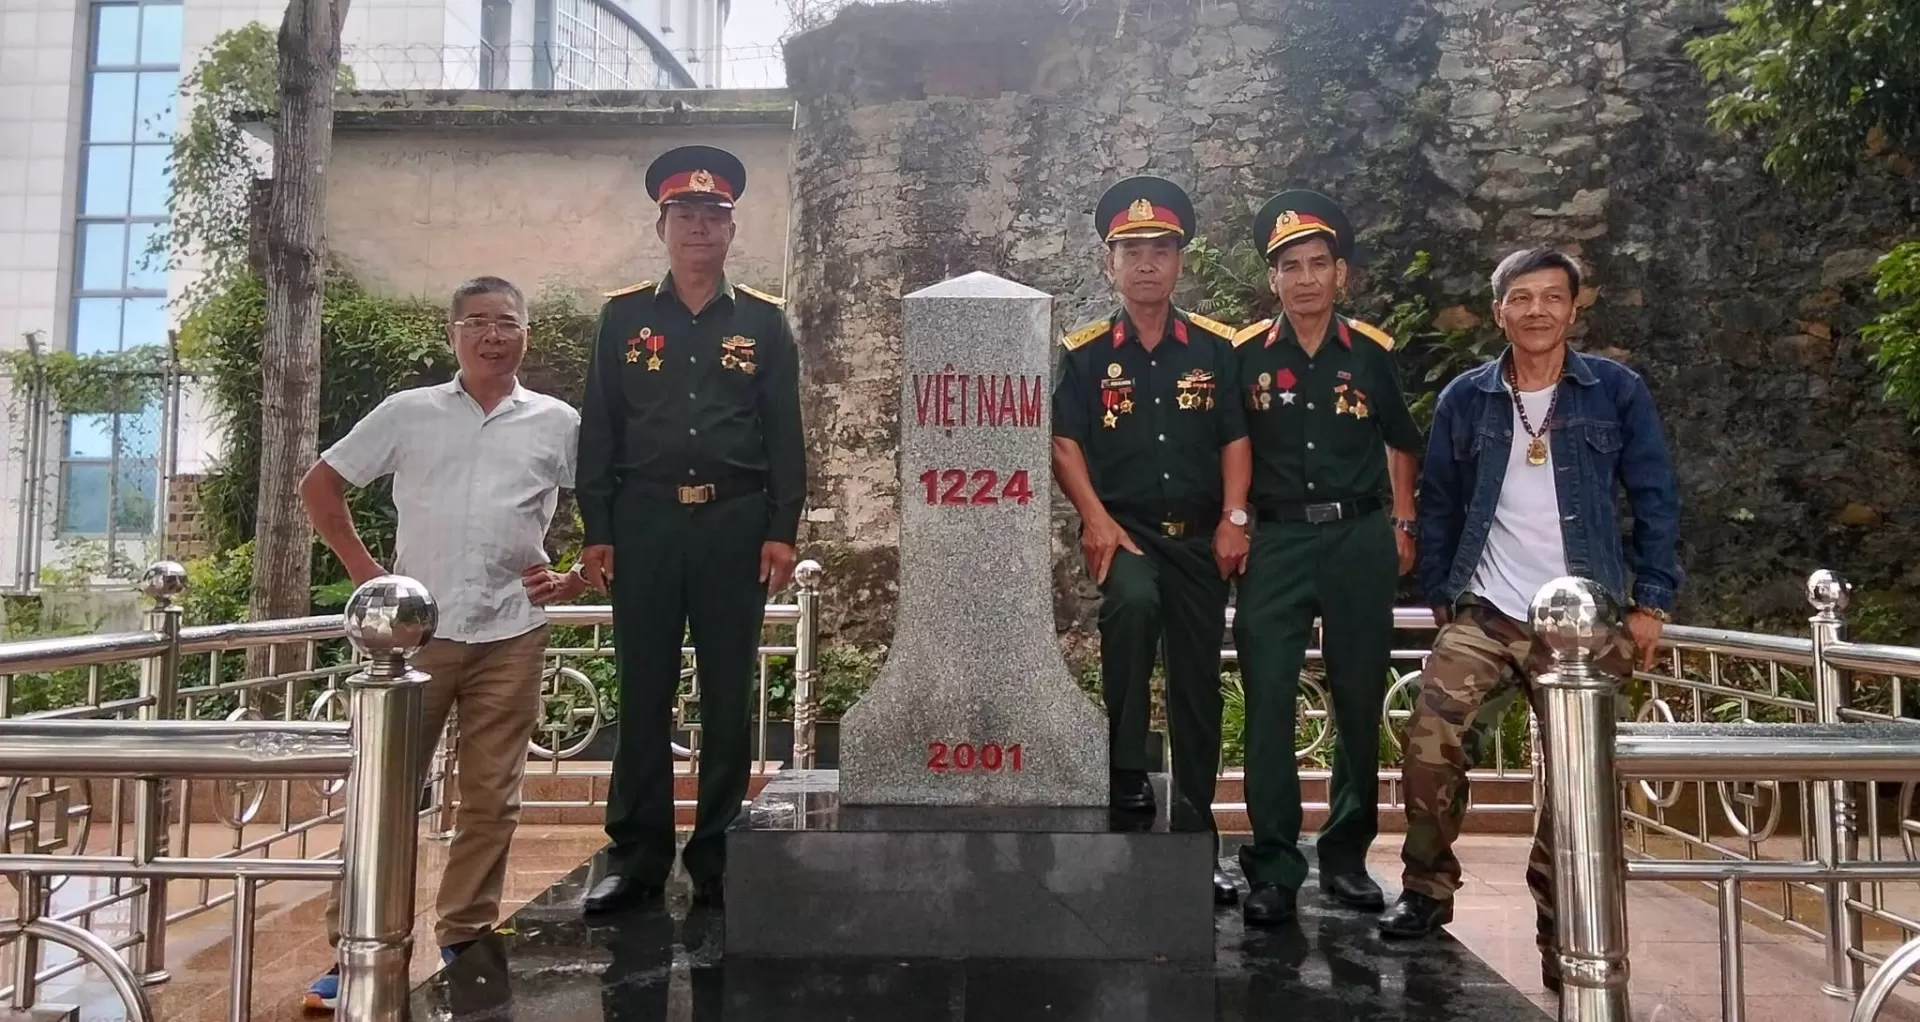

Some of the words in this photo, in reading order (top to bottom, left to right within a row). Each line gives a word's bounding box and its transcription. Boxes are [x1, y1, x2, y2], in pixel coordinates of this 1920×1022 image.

[912, 363, 969, 437] VIỆT
[977, 374, 1042, 428] NAM
[919, 468, 1033, 505] 1224
[926, 741, 1024, 773] 2001
